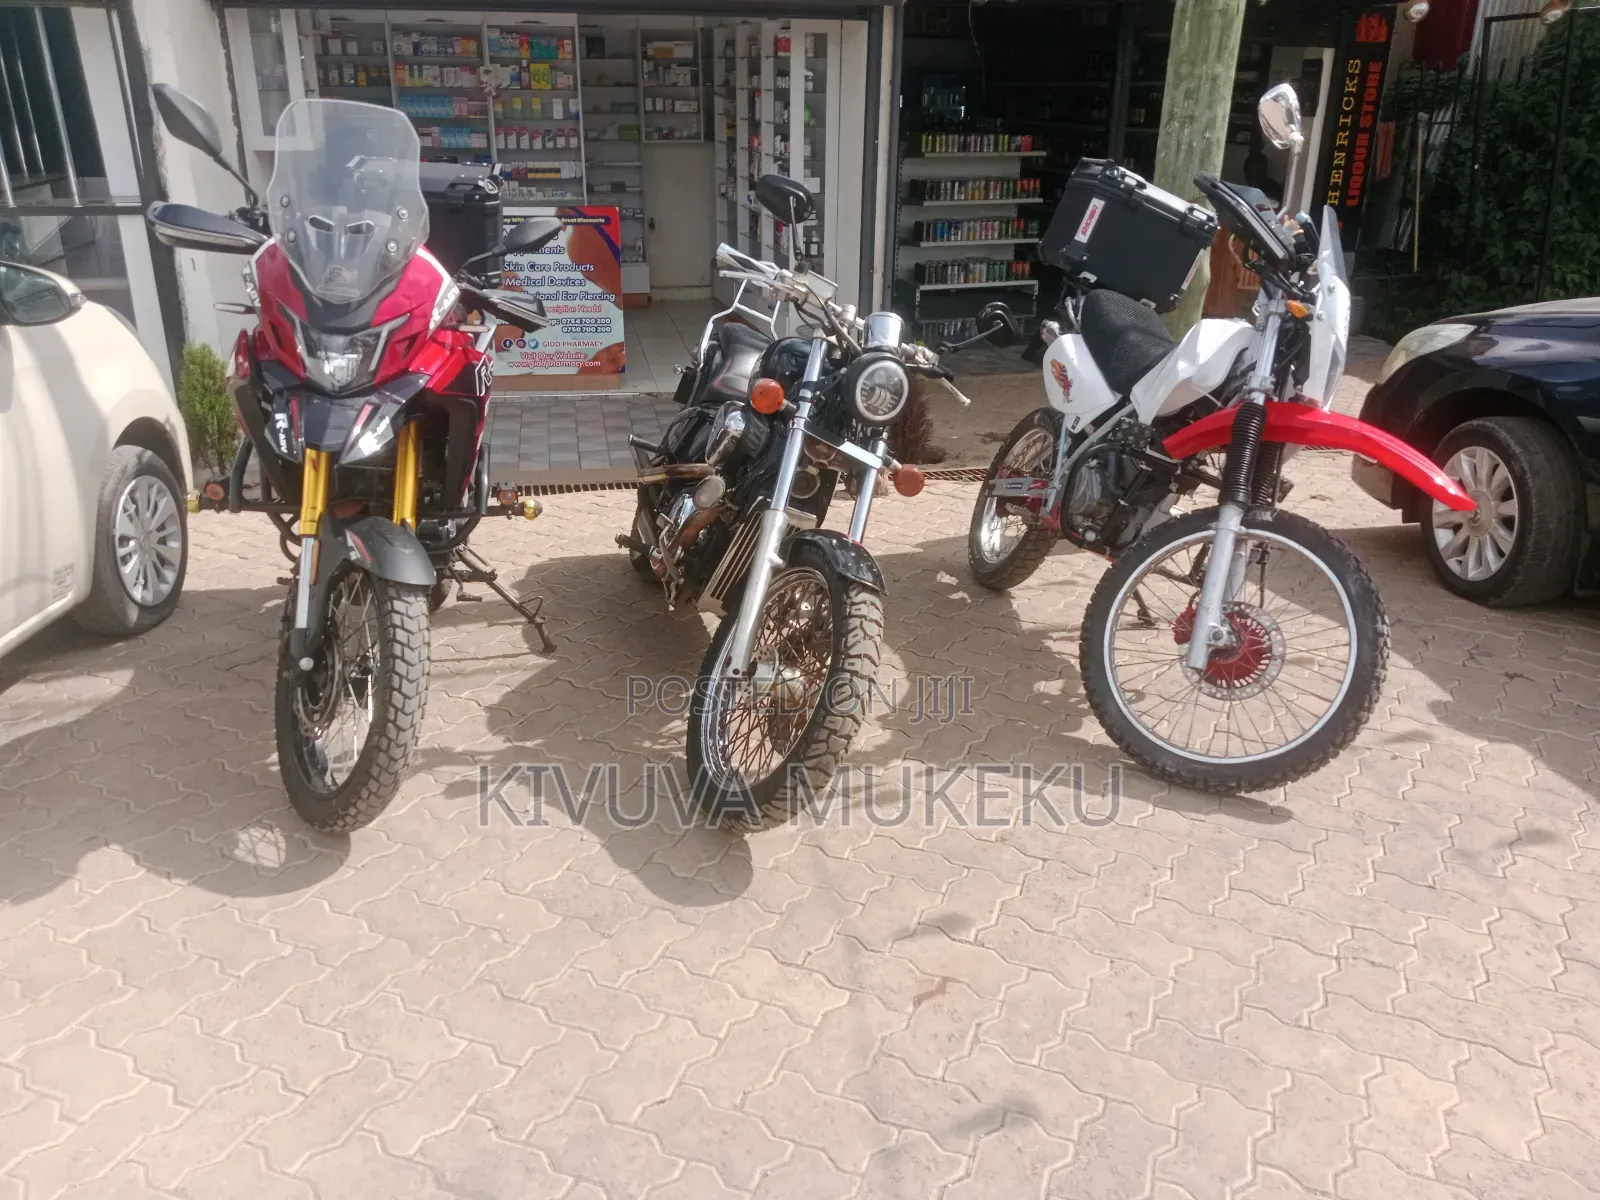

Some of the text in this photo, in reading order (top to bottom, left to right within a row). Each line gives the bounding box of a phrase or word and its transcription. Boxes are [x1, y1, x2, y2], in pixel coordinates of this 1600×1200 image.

[1359, 61, 1382, 128] STORE
[1327, 59, 1361, 206] HENRICKS
[503, 261, 595, 272] Skin Care Products
[504, 276, 587, 287] Medical Devices
[561, 291, 578, 301] Ear
[579, 291, 616, 303] Piercing
[520, 352, 588, 360] Visit Our Website:
[508, 360, 601, 368] www.giddpharmacy.com
[274, 413, 289, 453] R-ADV
